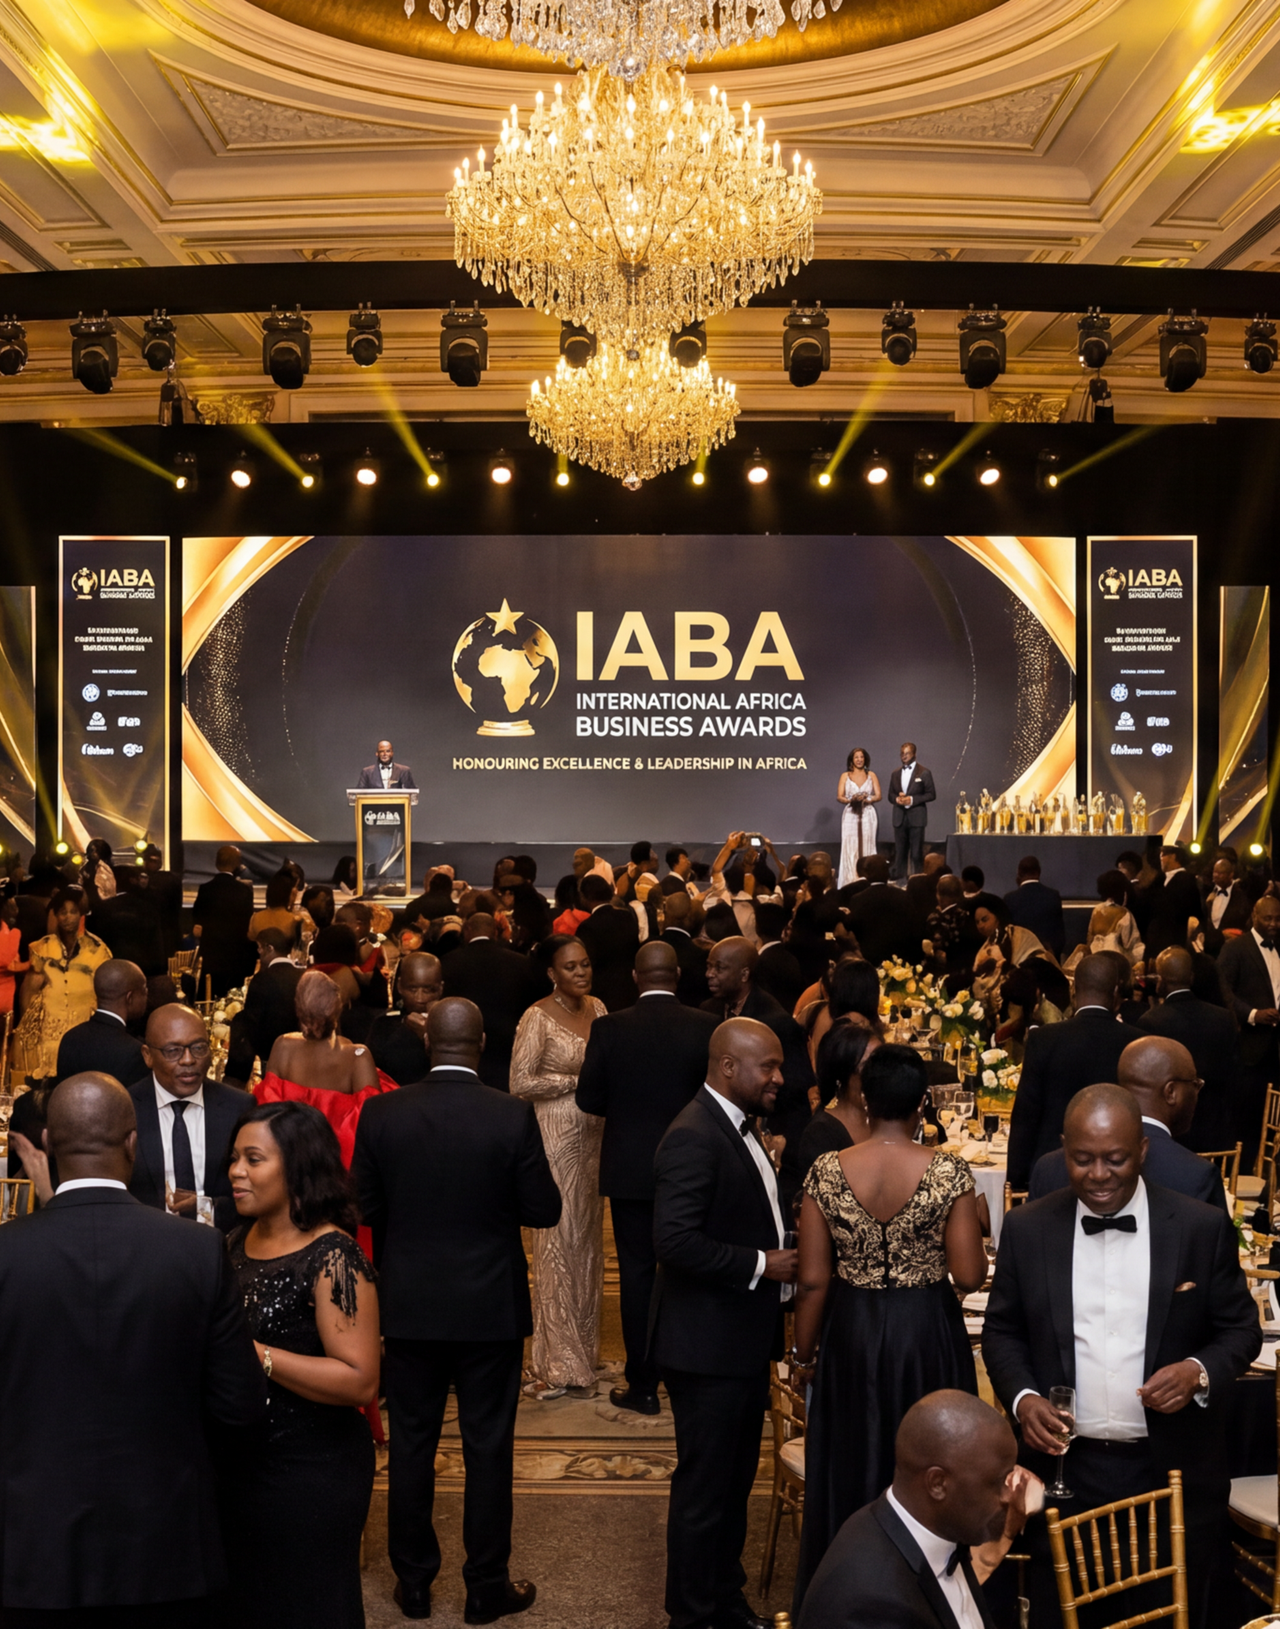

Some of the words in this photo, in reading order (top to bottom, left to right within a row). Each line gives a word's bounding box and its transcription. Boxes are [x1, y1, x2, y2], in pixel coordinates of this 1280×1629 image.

[100, 568, 155, 587] IABA
[1128, 568, 1183, 587] IABA
[576, 611, 806, 681] IABA
[576, 692, 731, 711] INTERNATIONAL
[735, 692, 807, 711] AFRICA
[576, 715, 693, 737] BUSINESS
[698, 715, 807, 737] AWARDS
[452, 757, 540, 770] HONOURING
[542, 757, 631, 770] EXCELLENCE
[647, 757, 735, 770] LEADERSHIP
[737, 757, 753, 770] IN
[755, 757, 807, 770] AFRICA
